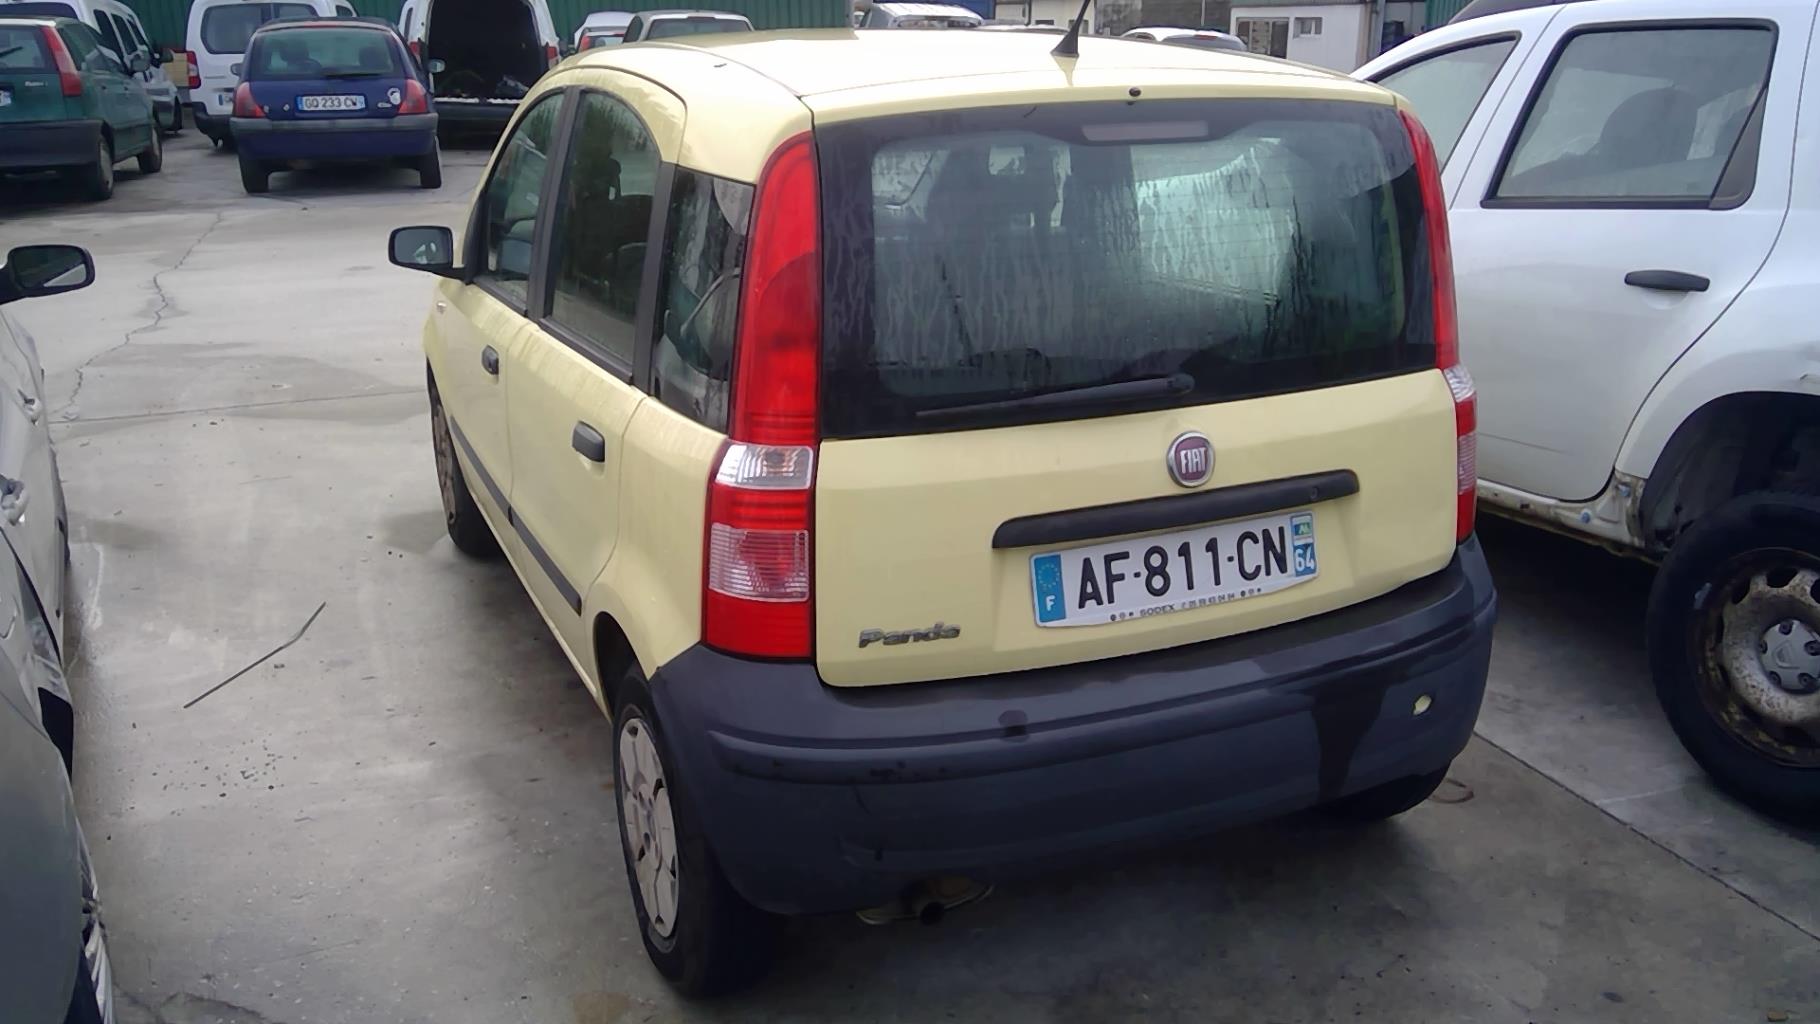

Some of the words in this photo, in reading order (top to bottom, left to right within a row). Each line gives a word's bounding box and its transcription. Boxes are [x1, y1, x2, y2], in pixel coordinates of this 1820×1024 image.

[321, 97, 342, 108] 233
[1180, 447, 1206, 474] FIAT
[1077, 526, 1288, 609] AF-811-CN
[1295, 546, 1315, 572] 64
[1045, 594, 1056, 612] F
[858, 620, 961, 649] Panda
